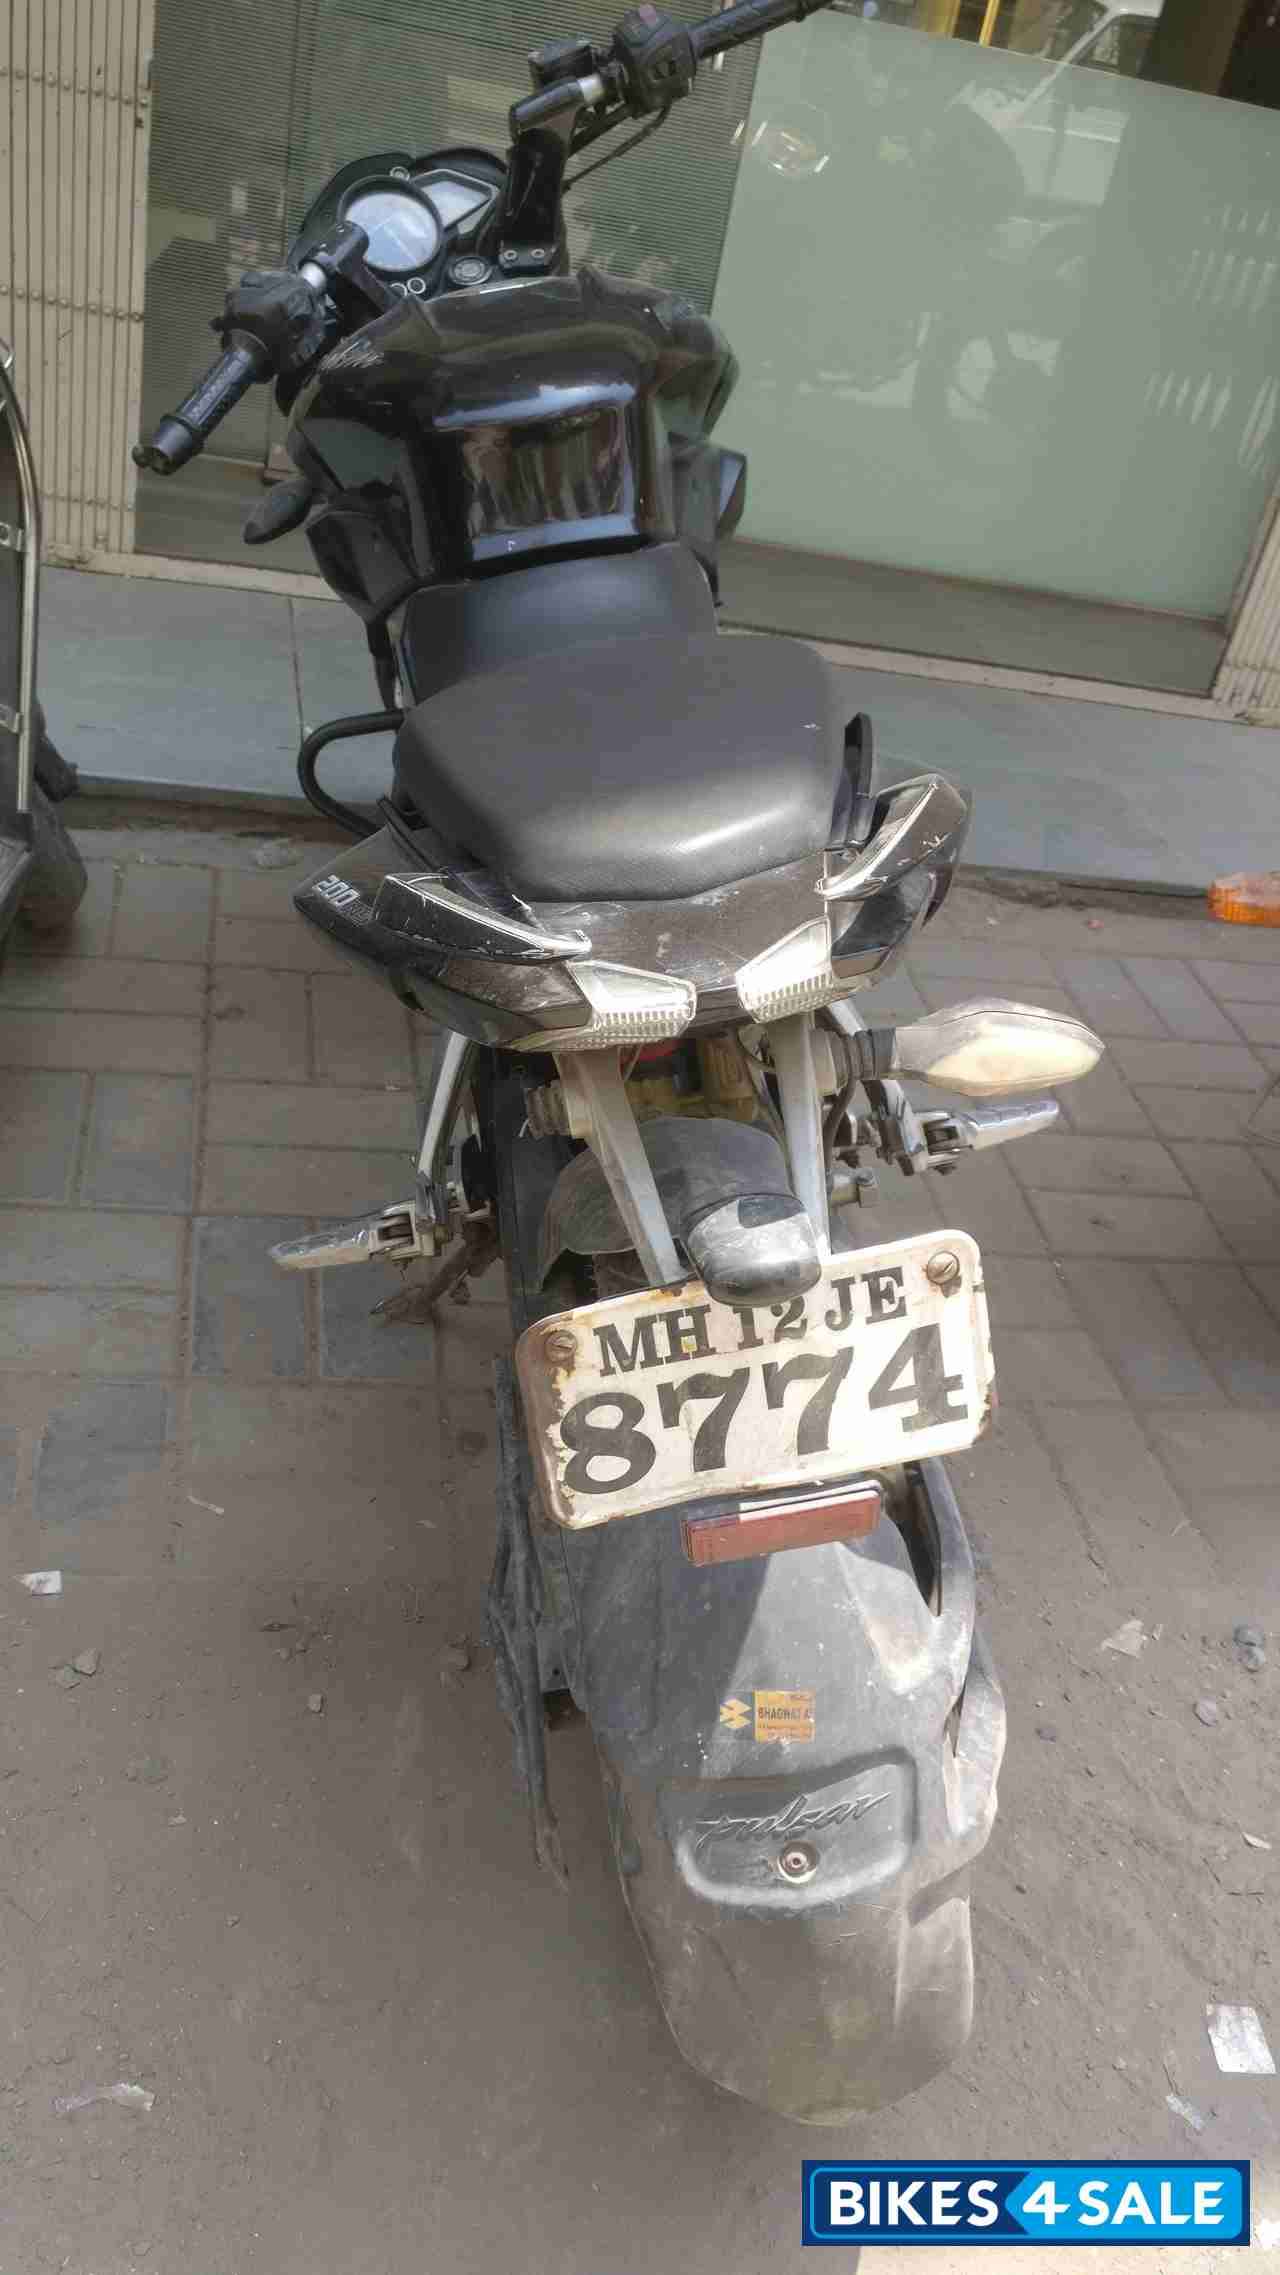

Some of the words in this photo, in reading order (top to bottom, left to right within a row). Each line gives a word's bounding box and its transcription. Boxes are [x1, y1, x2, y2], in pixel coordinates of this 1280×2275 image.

[312, 874, 360, 907] 200
[593, 1303, 717, 1377] MH
[733, 1296, 808, 1350] 12
[825, 1266, 906, 1331] JE
[559, 1322, 969, 1495] 8774
